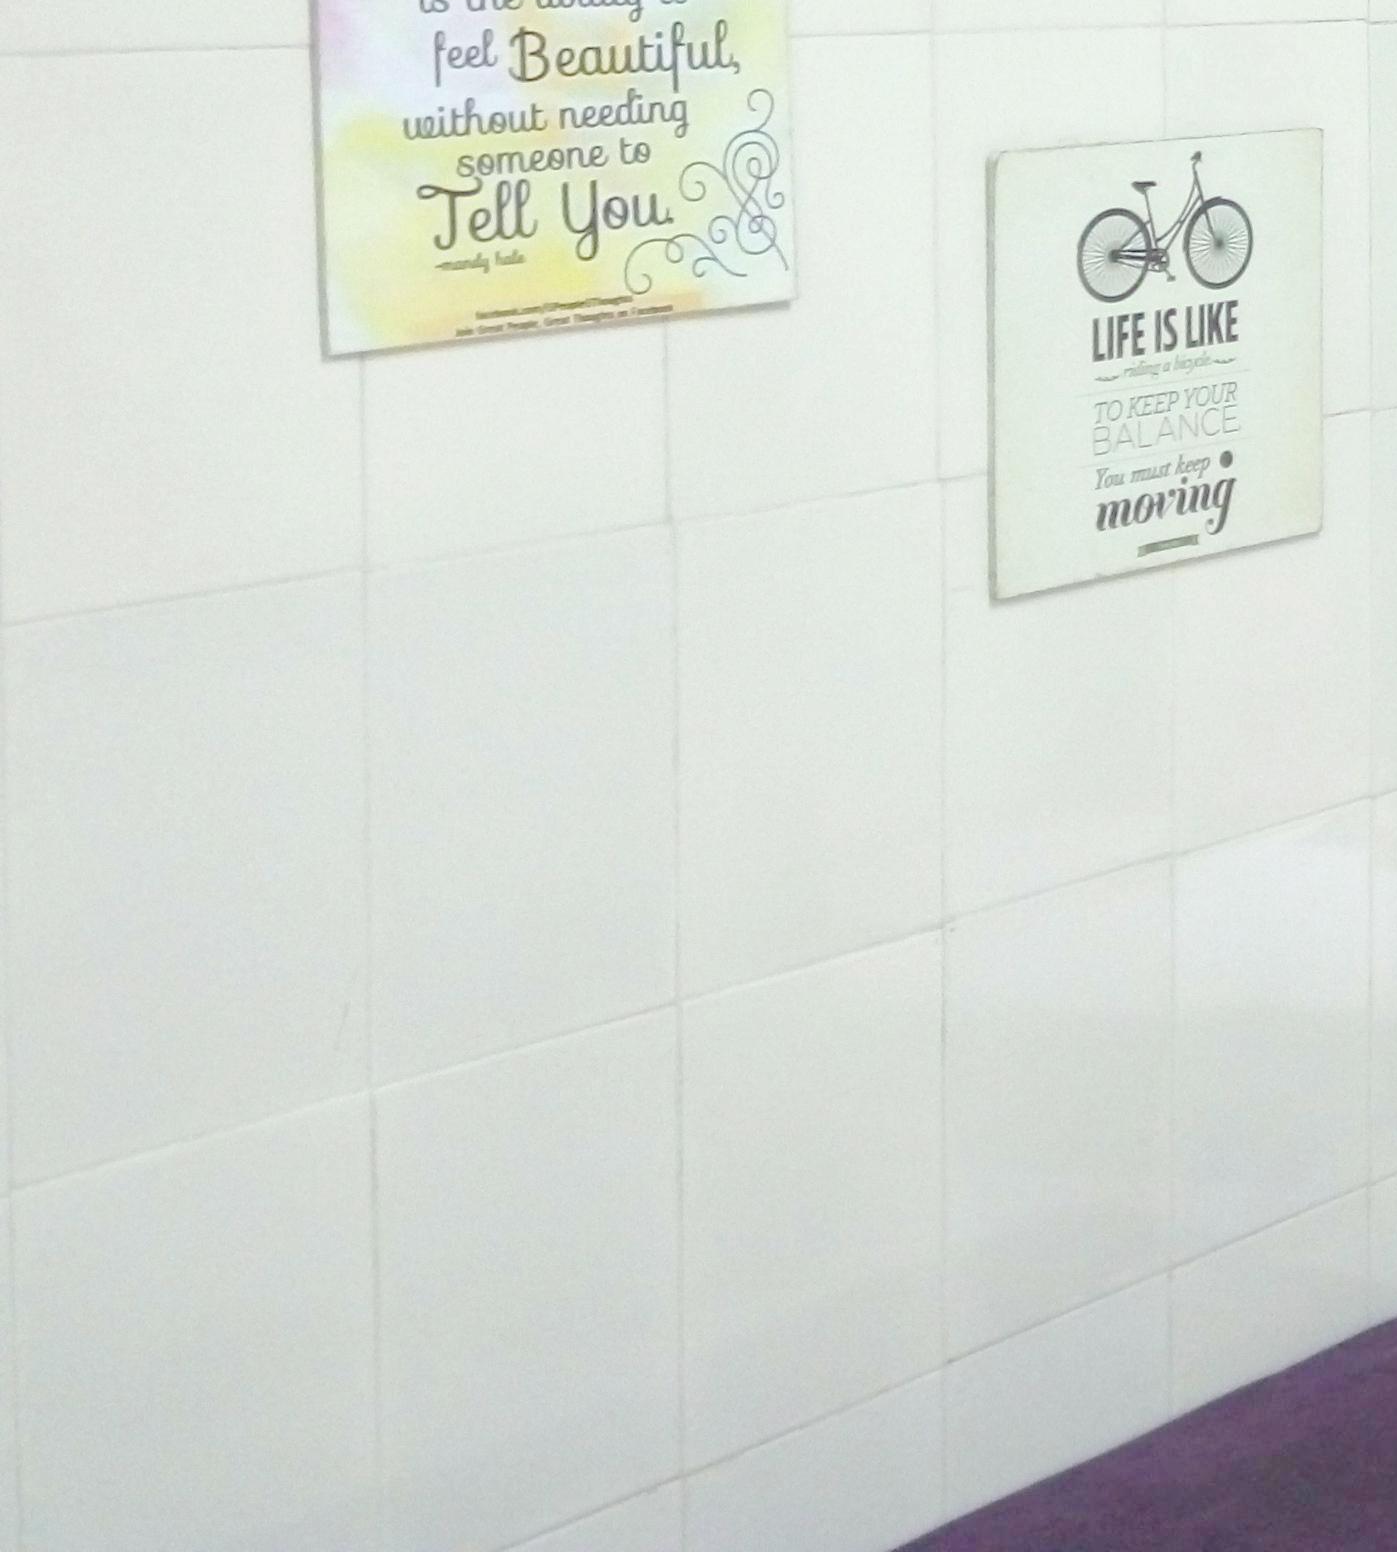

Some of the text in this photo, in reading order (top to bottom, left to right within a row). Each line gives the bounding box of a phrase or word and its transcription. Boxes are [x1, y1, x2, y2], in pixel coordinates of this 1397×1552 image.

[432, 18, 742, 94] feel Beautiful,
[402, 87, 689, 141] without needing
[456, 138, 652, 180] someone to
[416, 177, 675, 263] Tell You.
[1093, 300, 1239, 362] LIFE IS LIKE
[1162, 362, 1171, 373] a
[1093, 403, 1241, 457] BALANCE
[1094, 381, 1239, 425] TO KEEP YOUR
[1094, 454, 1211, 491] You must keep
[1095, 476, 1237, 536] moving
